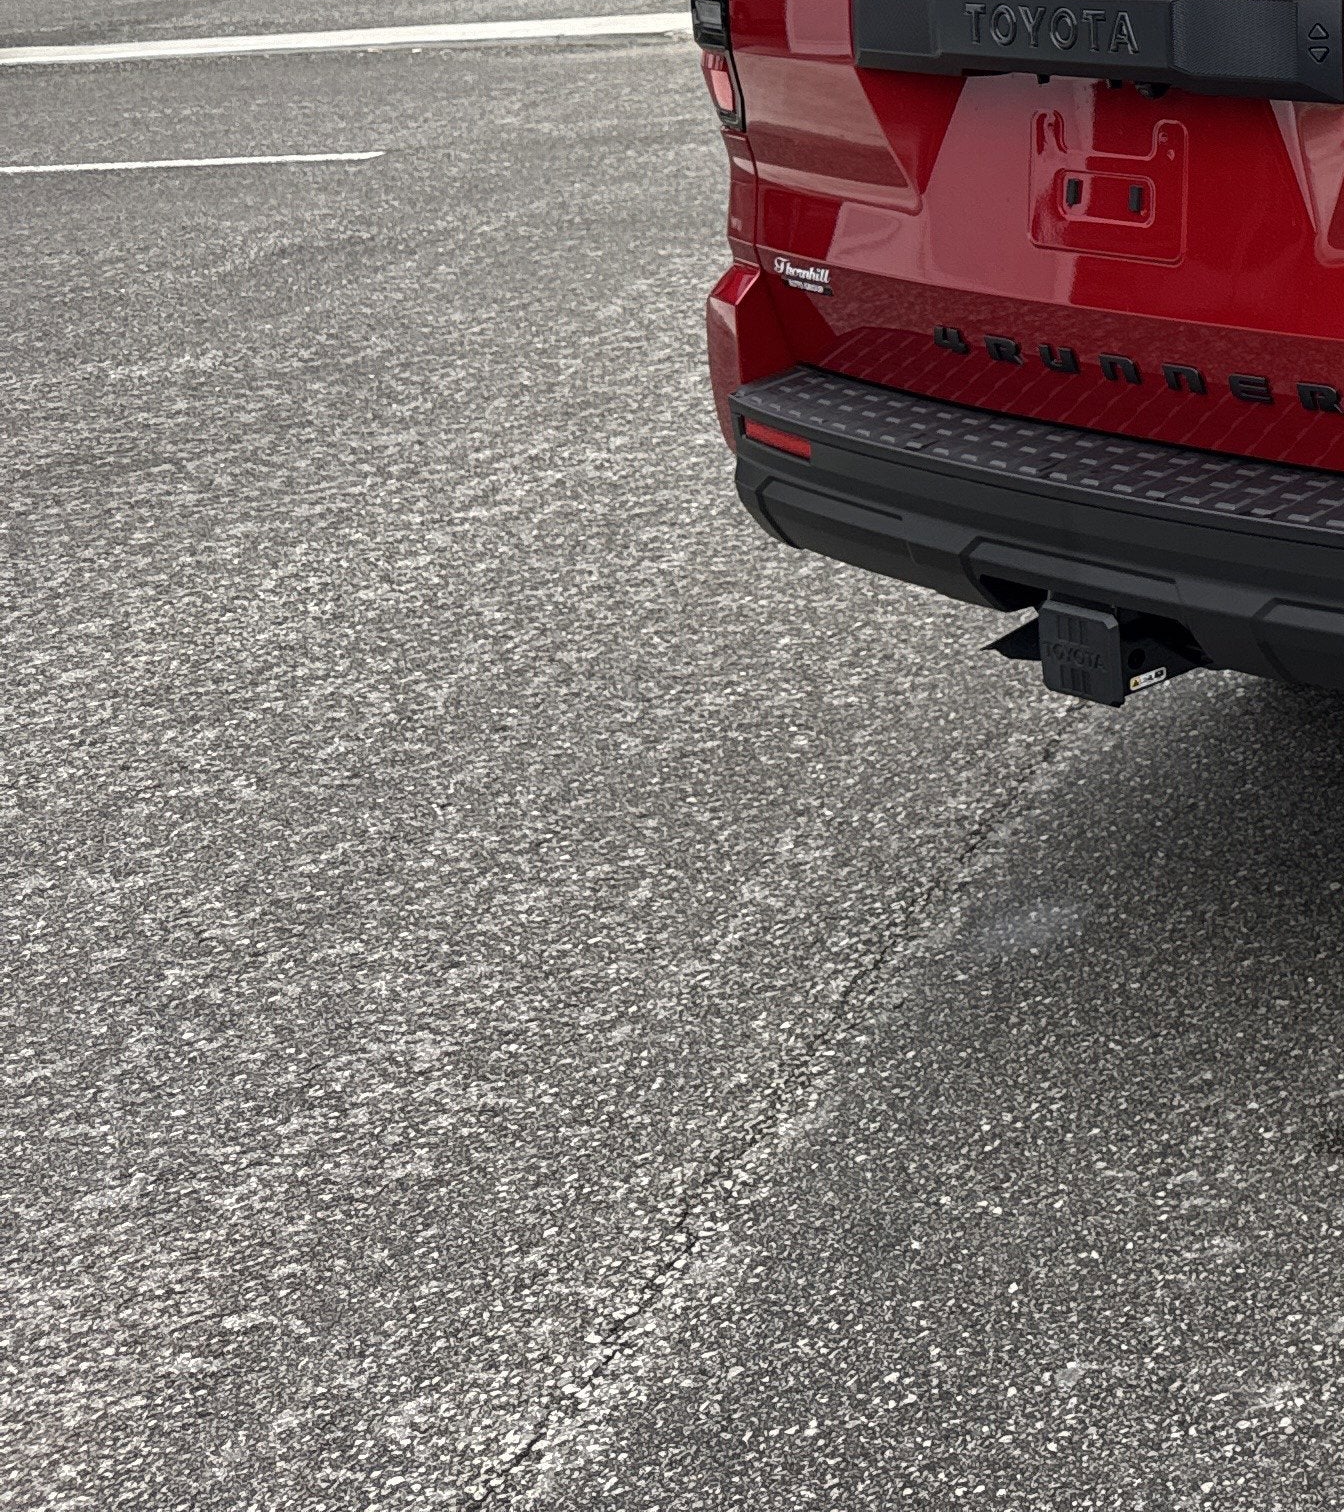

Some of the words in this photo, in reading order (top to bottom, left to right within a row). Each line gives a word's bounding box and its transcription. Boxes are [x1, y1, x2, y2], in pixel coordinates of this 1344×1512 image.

[964, 2, 1140, 55] TOYOTA
[774, 256, 831, 284] Thornhill
[932, 324, 1344, 414] 4RUNNER
[1041, 640, 1105, 671] TOYOTA
